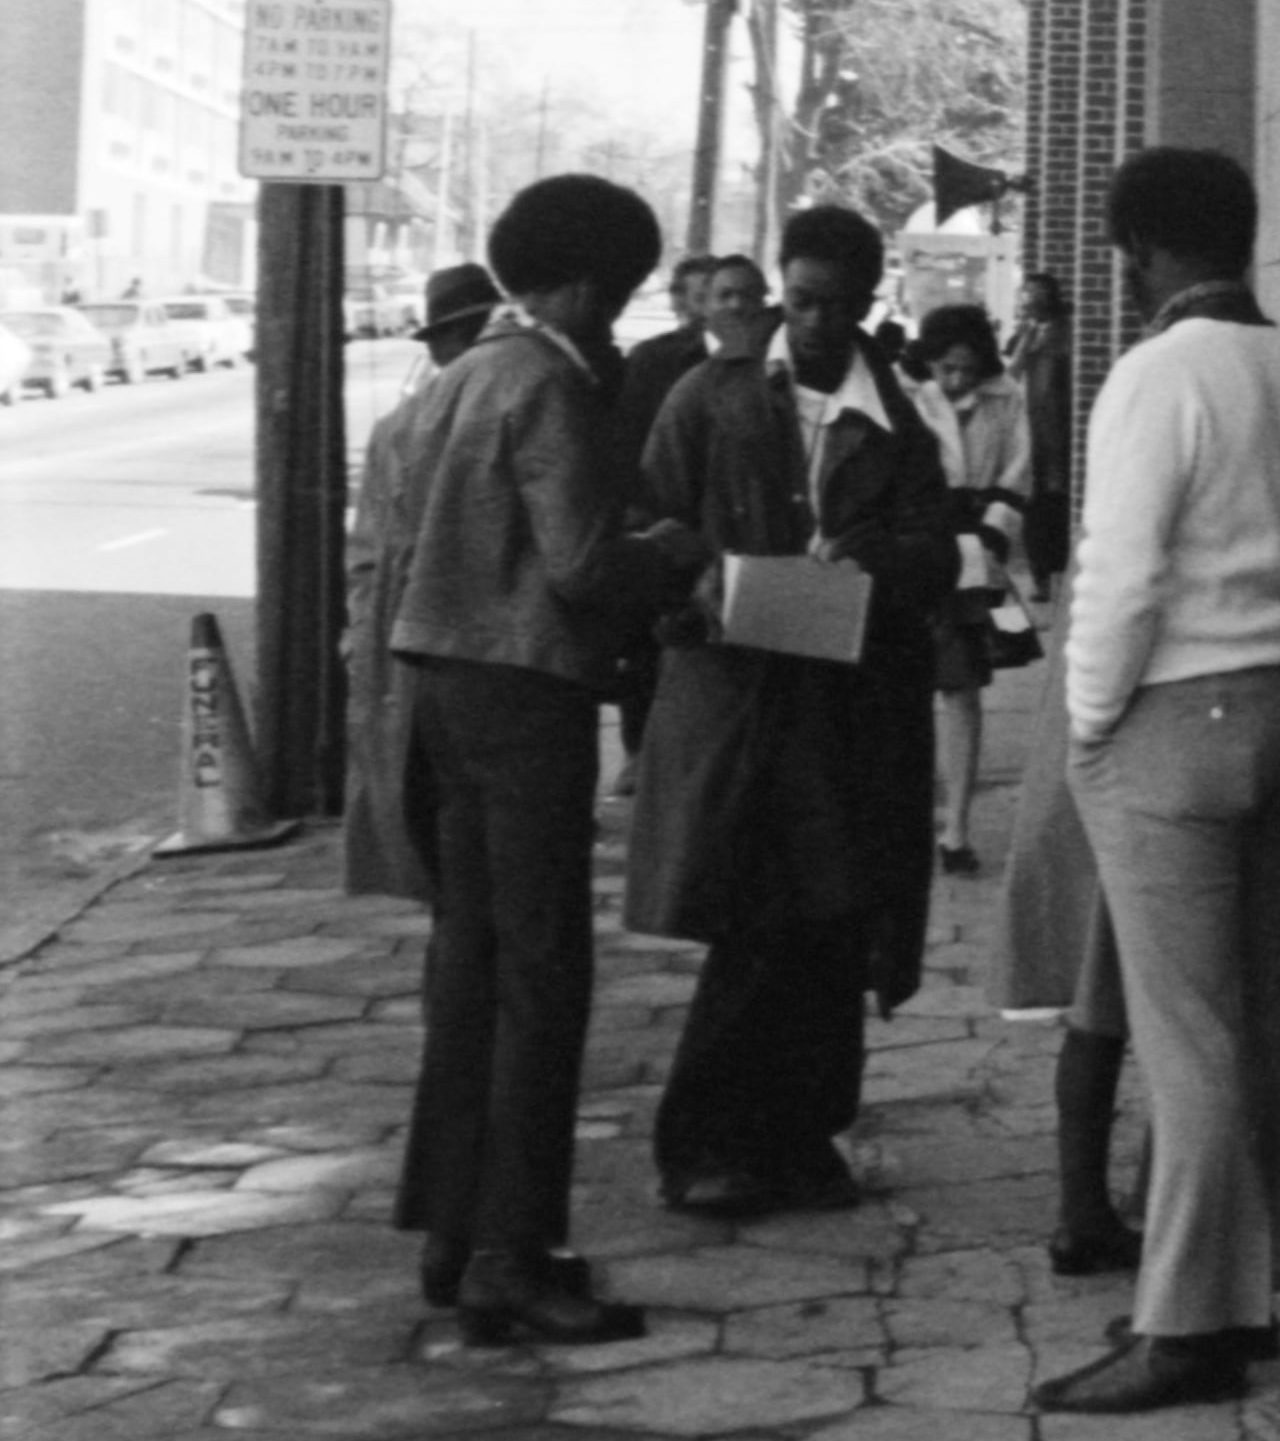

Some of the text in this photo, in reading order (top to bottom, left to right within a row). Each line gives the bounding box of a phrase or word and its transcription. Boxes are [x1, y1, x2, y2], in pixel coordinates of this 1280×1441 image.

[255, 5, 381, 33] NO PARKING
[306, 39, 329, 56] TO
[254, 60, 297, 79] 4PM
[305, 62, 328, 80] TO
[248, 91, 377, 119] ONE HOUR
[276, 124, 349, 142] PARKING
[303, 150, 325, 168] TO
[189, 656, 220, 788] FUNERAL
